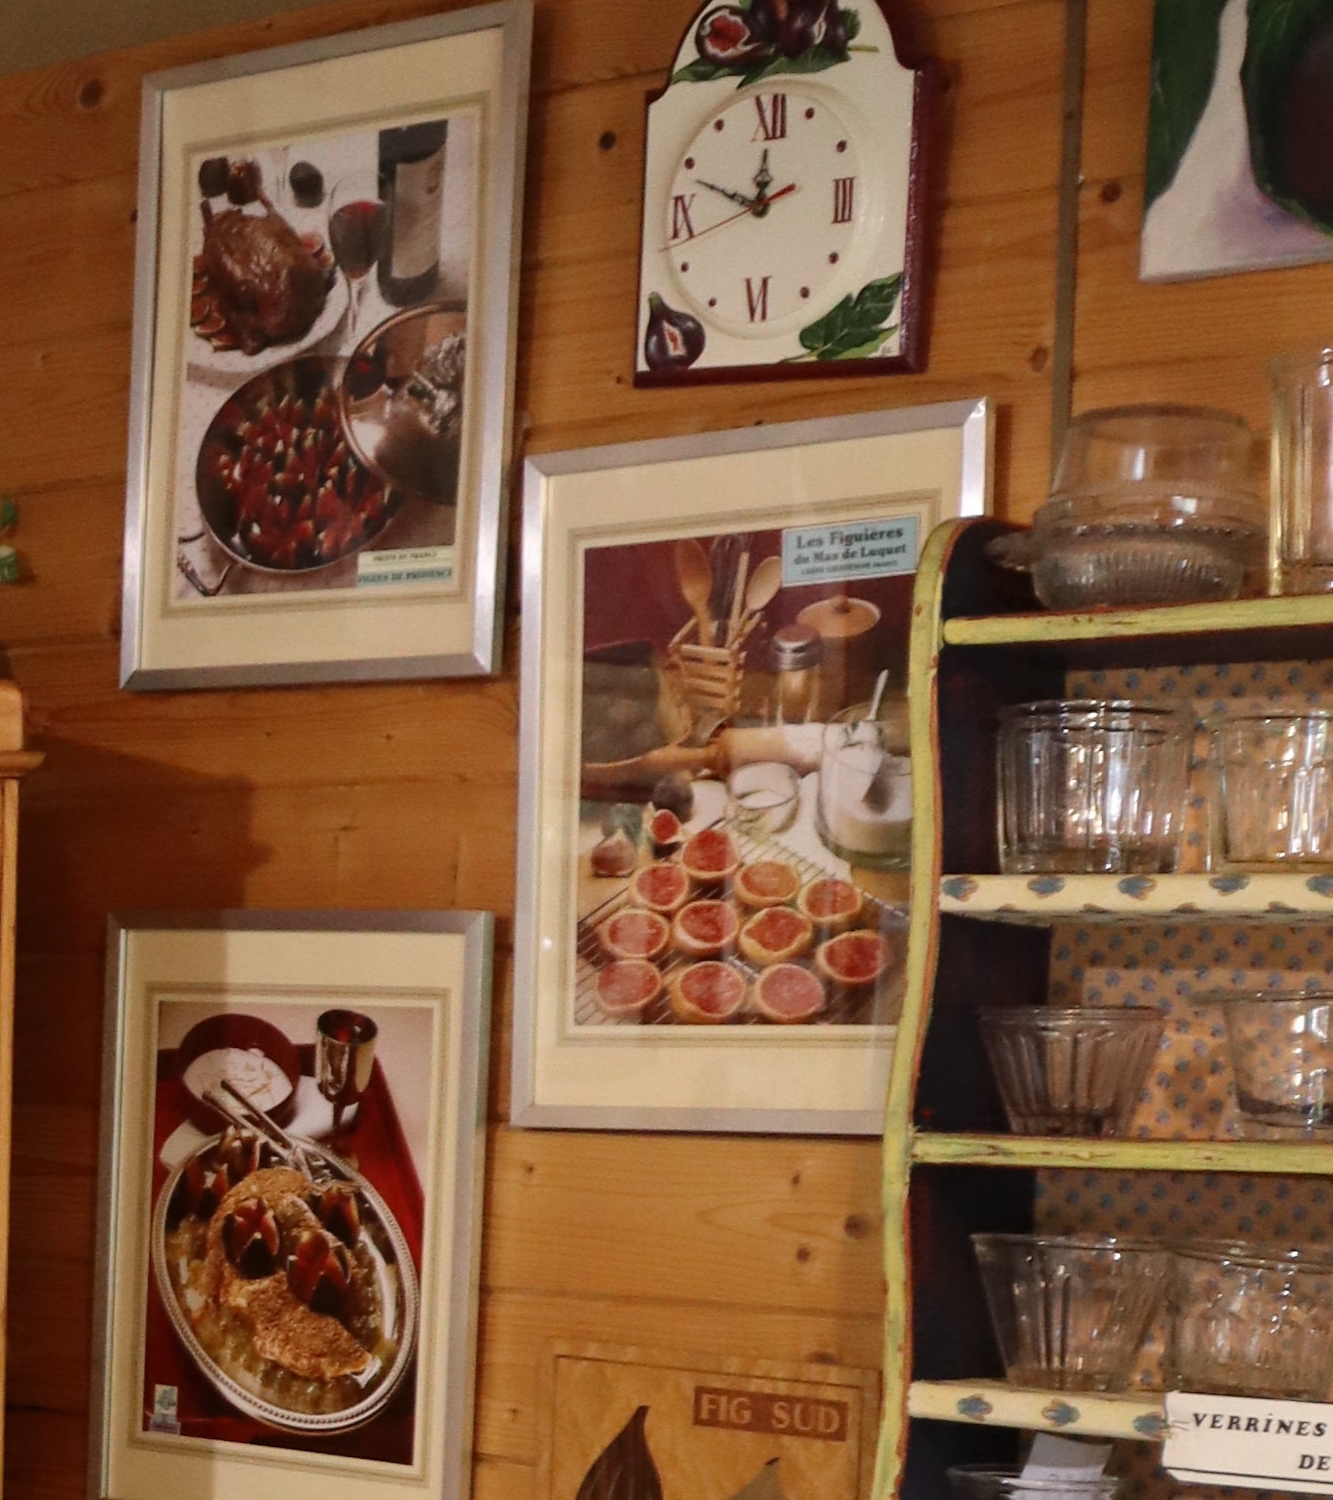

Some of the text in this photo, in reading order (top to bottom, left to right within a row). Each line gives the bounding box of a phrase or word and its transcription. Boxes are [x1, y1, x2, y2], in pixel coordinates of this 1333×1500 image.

[750, 94, 787, 142] XII
[669, 193, 697, 240] IX
[831, 177, 855, 224] III
[745, 276, 772, 323] VI
[797, 527, 903, 549] Les Figuières
[700, 1393, 840, 1433] FIG SUD
